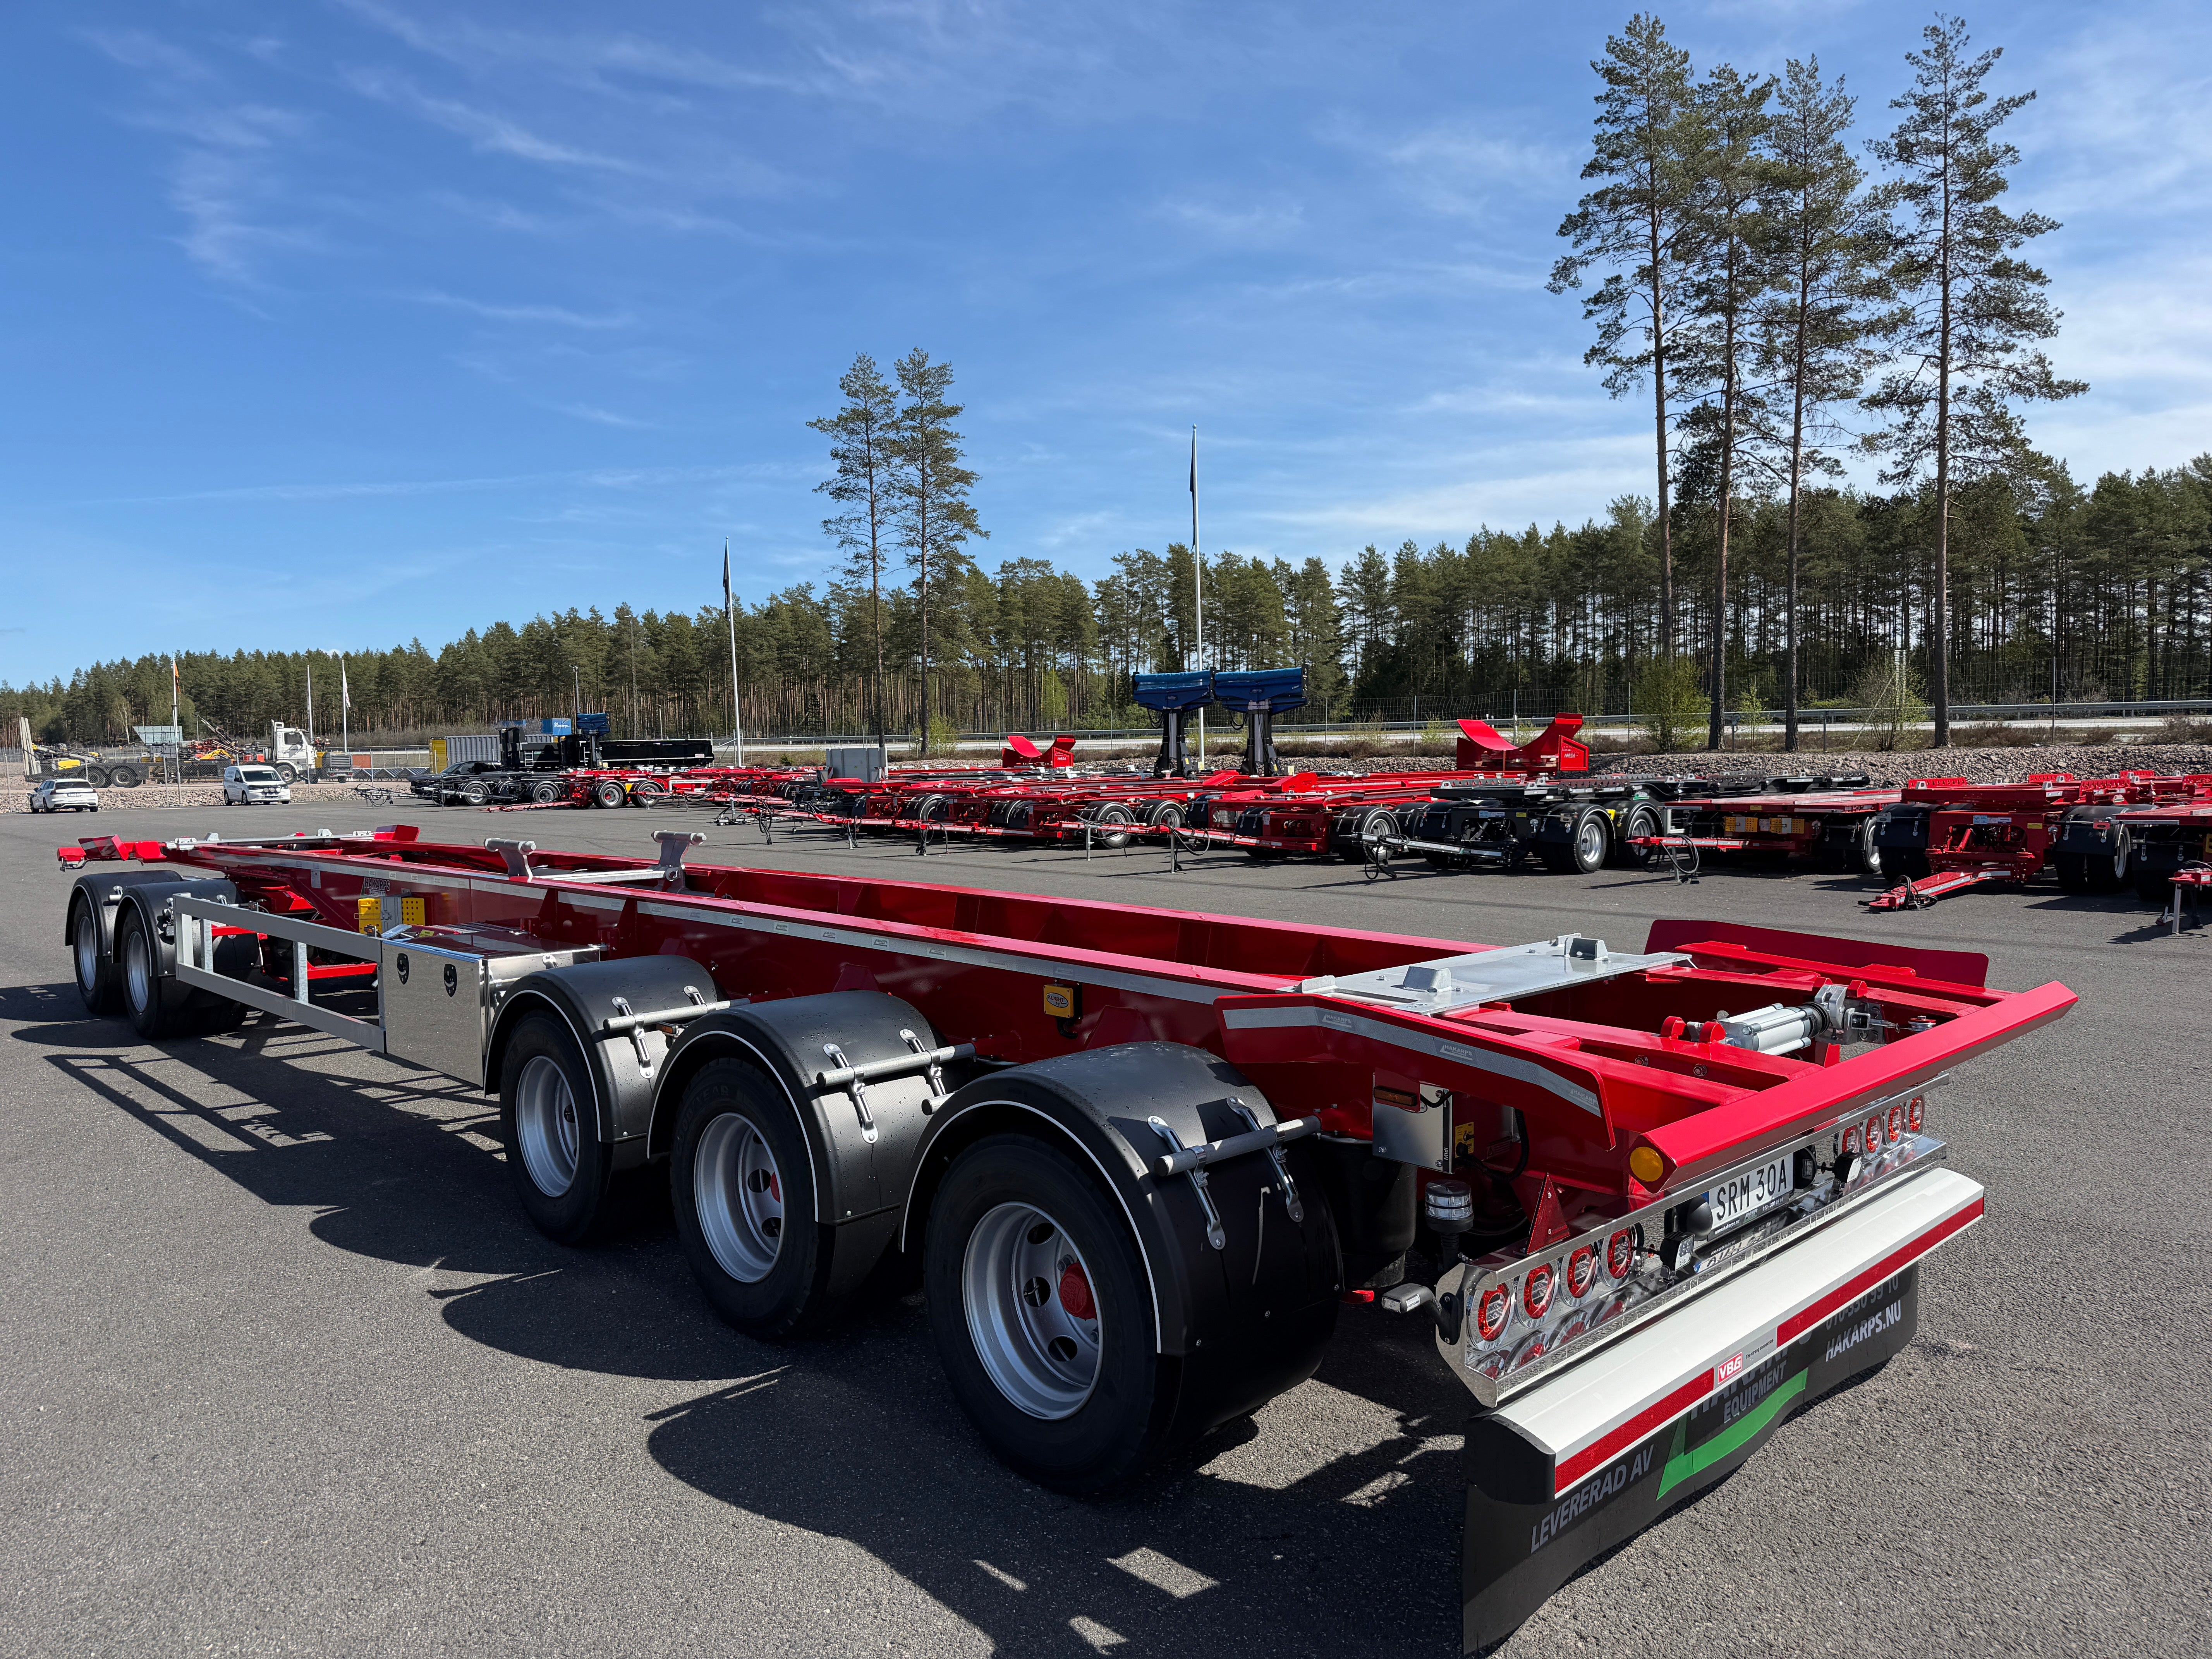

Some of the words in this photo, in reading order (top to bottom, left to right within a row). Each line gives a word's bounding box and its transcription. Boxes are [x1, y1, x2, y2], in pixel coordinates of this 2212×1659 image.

[364, 877, 390, 891] HAKARPS
[1326, 1014, 1351, 1023] HAKARPS
[1445, 1044, 1472, 1056] HAKARPS
[1717, 1175, 1750, 1221] SRM
[1756, 1159, 1787, 1202] 30A
[1826, 1300, 1901, 1362] HAKARPS.NU
[1719, 1356, 1741, 1379] VBG
[1724, 1360, 1787, 1424] EQUIPMENT
[1530, 1464, 1627, 1554] LEVERERAD
[1630, 1444, 1654, 1482] AV
